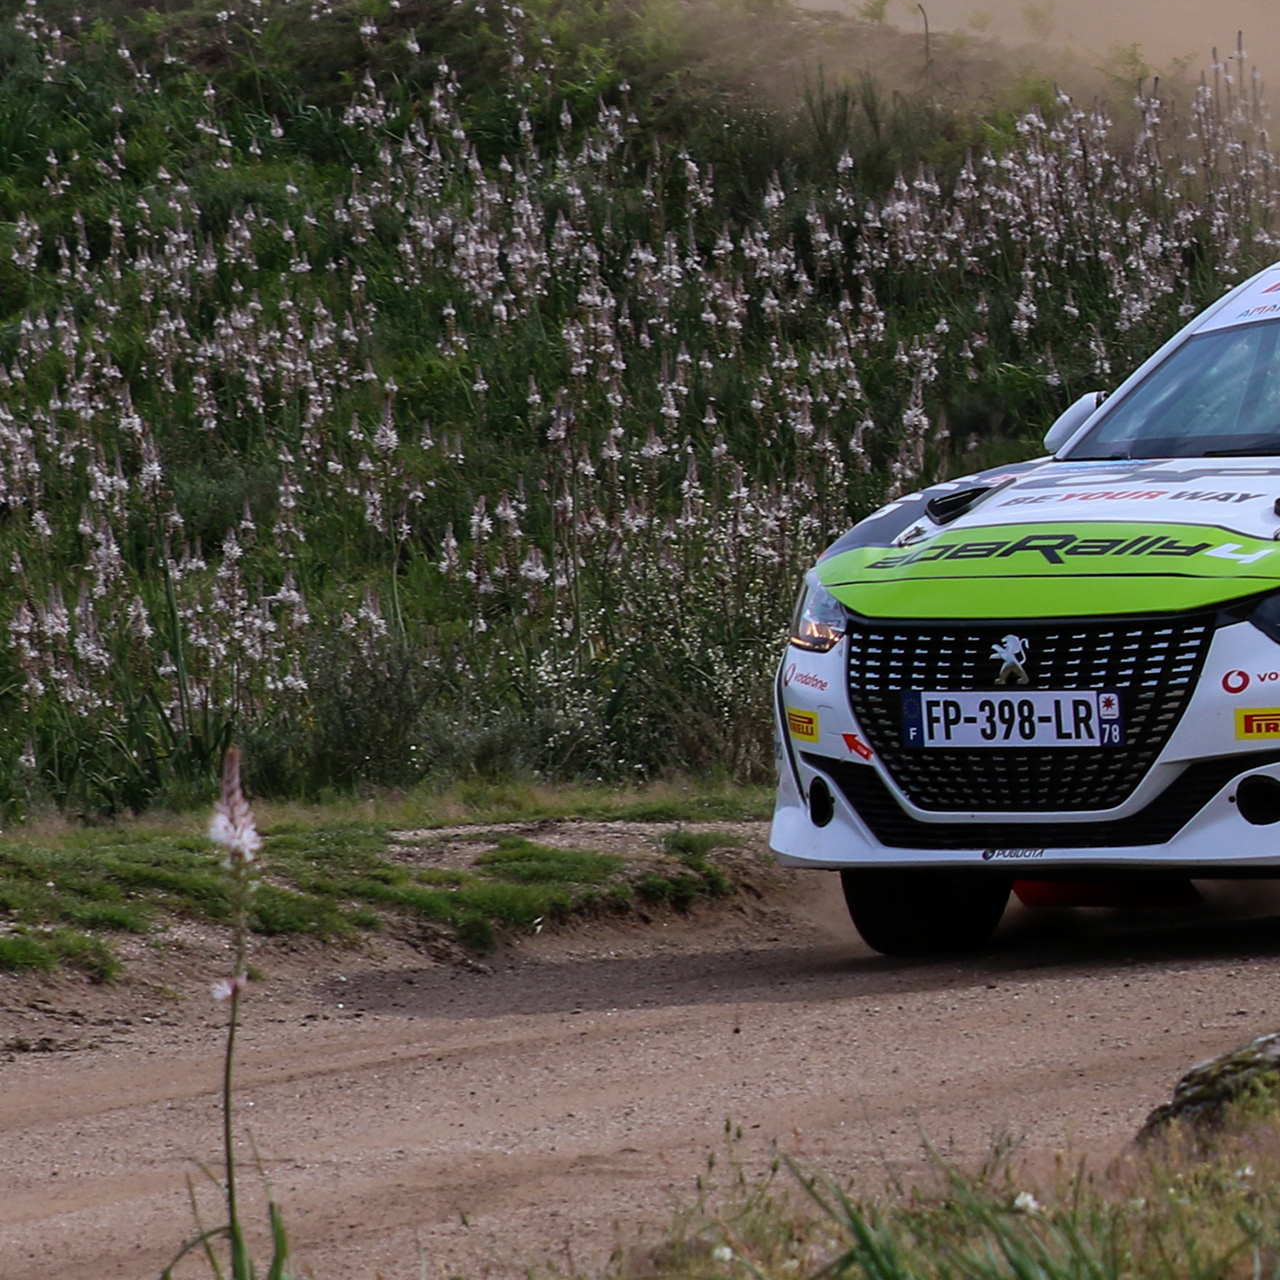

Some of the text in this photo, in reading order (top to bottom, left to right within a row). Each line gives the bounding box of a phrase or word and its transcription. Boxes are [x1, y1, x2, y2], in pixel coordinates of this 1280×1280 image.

[1056, 490, 1170, 503] YOUR
[1167, 490, 1268, 504] WAY
[793, 671, 829, 691] vodafone
[925, 699, 1096, 741] FP-398-LR
[909, 727, 918, 741] F
[1101, 723, 1121, 744] 78
